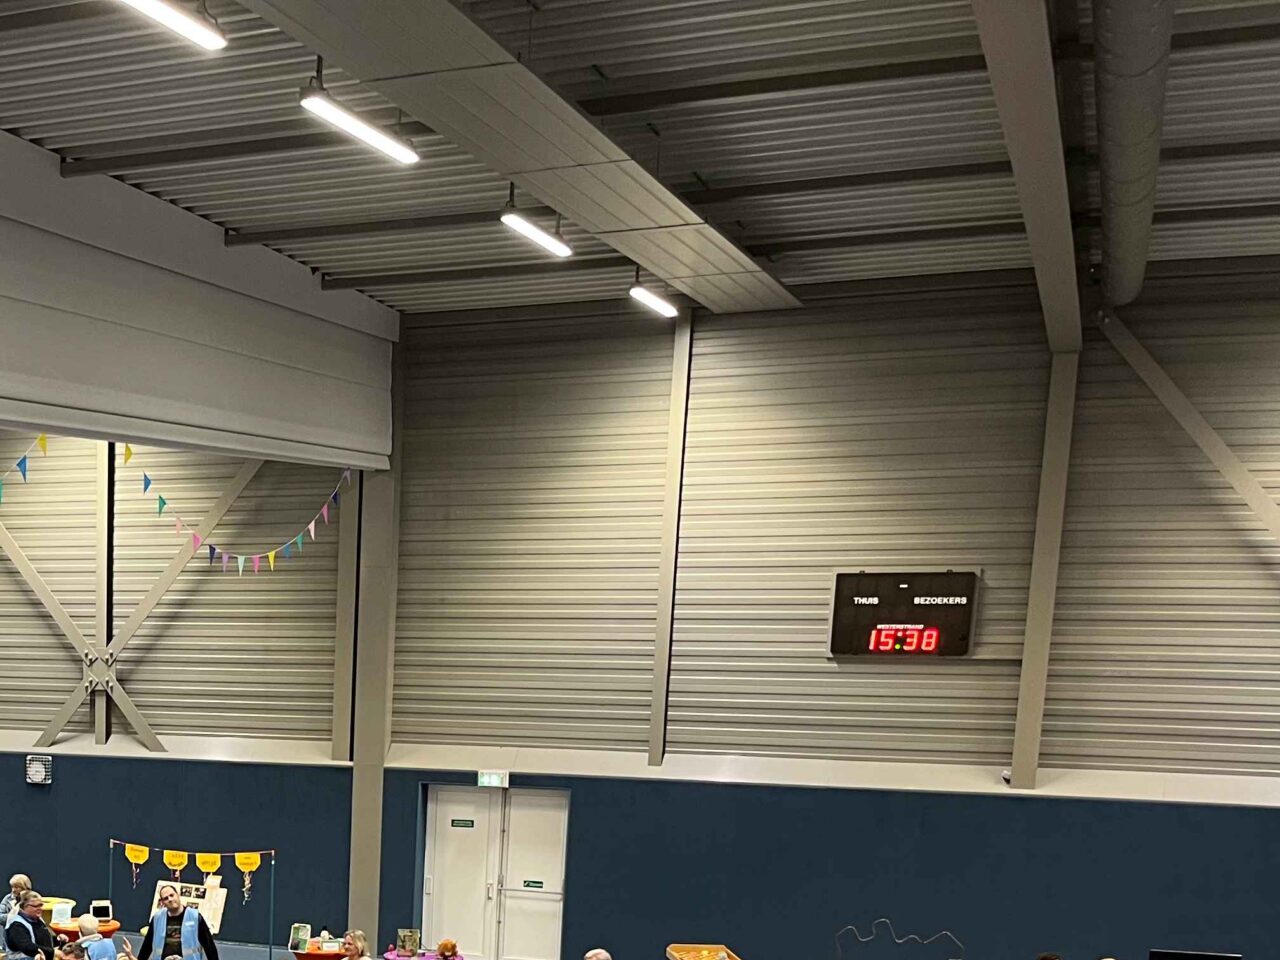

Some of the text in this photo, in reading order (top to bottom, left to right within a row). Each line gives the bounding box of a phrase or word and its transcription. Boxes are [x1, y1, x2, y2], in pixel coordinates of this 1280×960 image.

[853, 596, 968, 605] THUIS BEZOEKERS
[868, 629, 938, 651] 15:38
